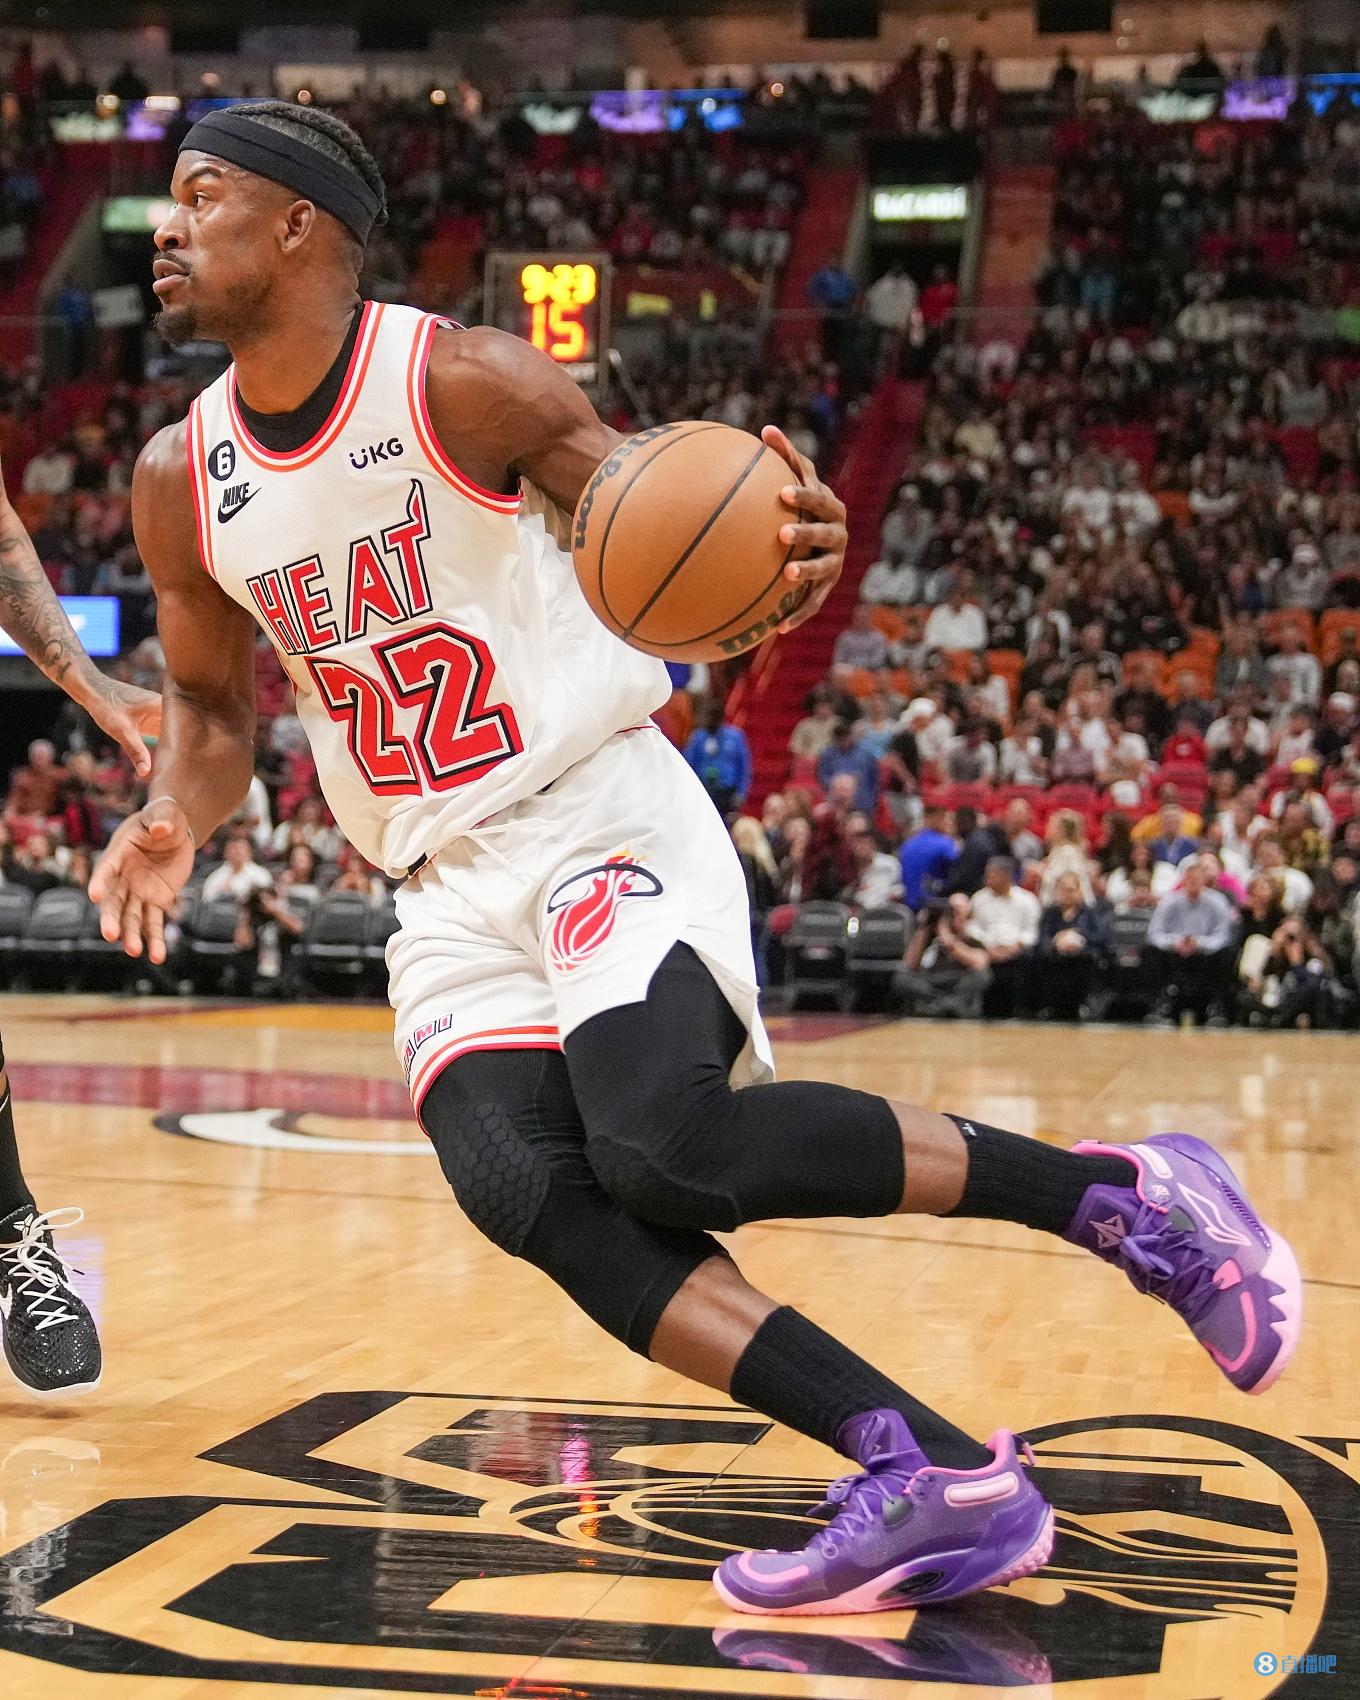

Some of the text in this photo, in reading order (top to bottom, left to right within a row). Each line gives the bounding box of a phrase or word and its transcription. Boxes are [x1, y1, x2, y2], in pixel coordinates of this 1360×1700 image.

[532, 302, 585, 361] 15
[213, 444, 233, 478] 6
[222, 481, 251, 509] NIKE
[246, 478, 434, 656] HEAT
[304, 621, 525, 797] 22
